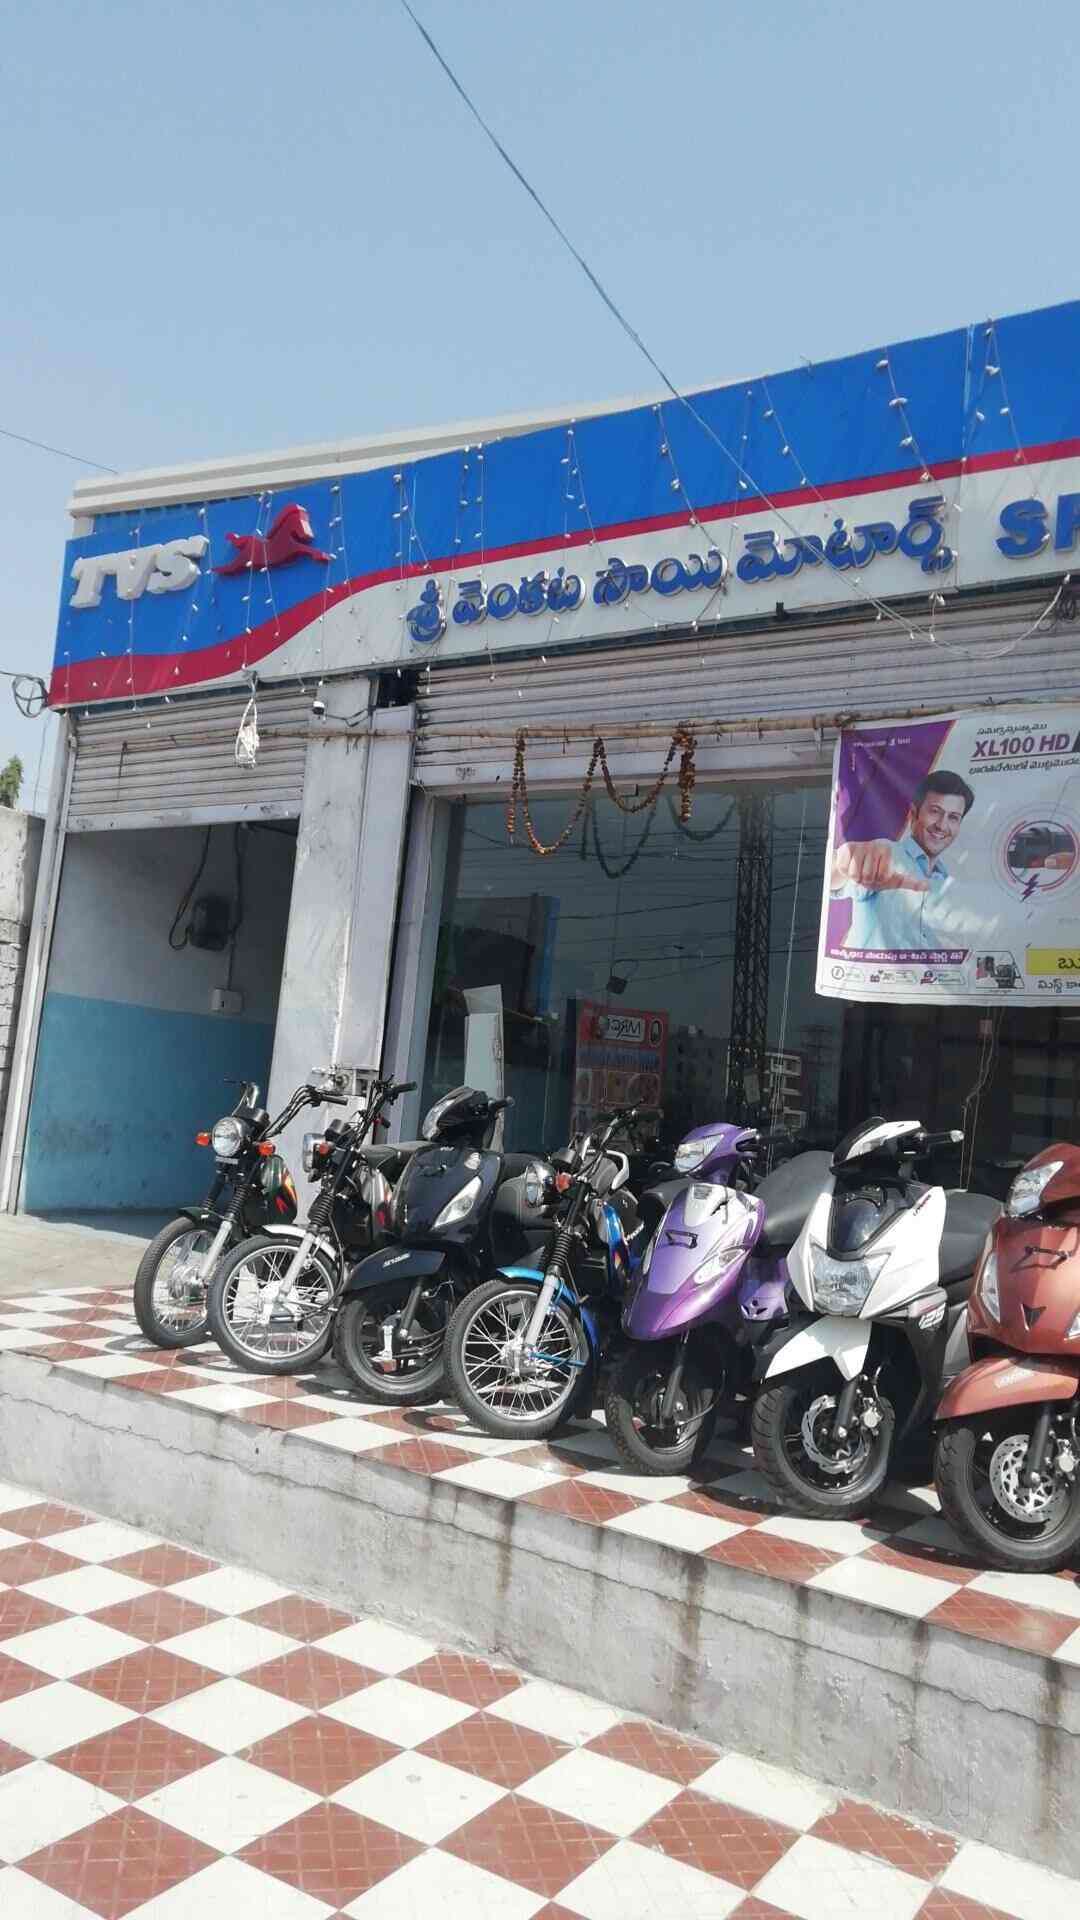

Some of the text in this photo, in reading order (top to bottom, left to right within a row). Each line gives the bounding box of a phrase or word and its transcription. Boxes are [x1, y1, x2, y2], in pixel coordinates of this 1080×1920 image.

[70, 534, 209, 608] TVS
[971, 733, 1071, 758] XL100 HD
[918, 1302, 946, 1330] 125
